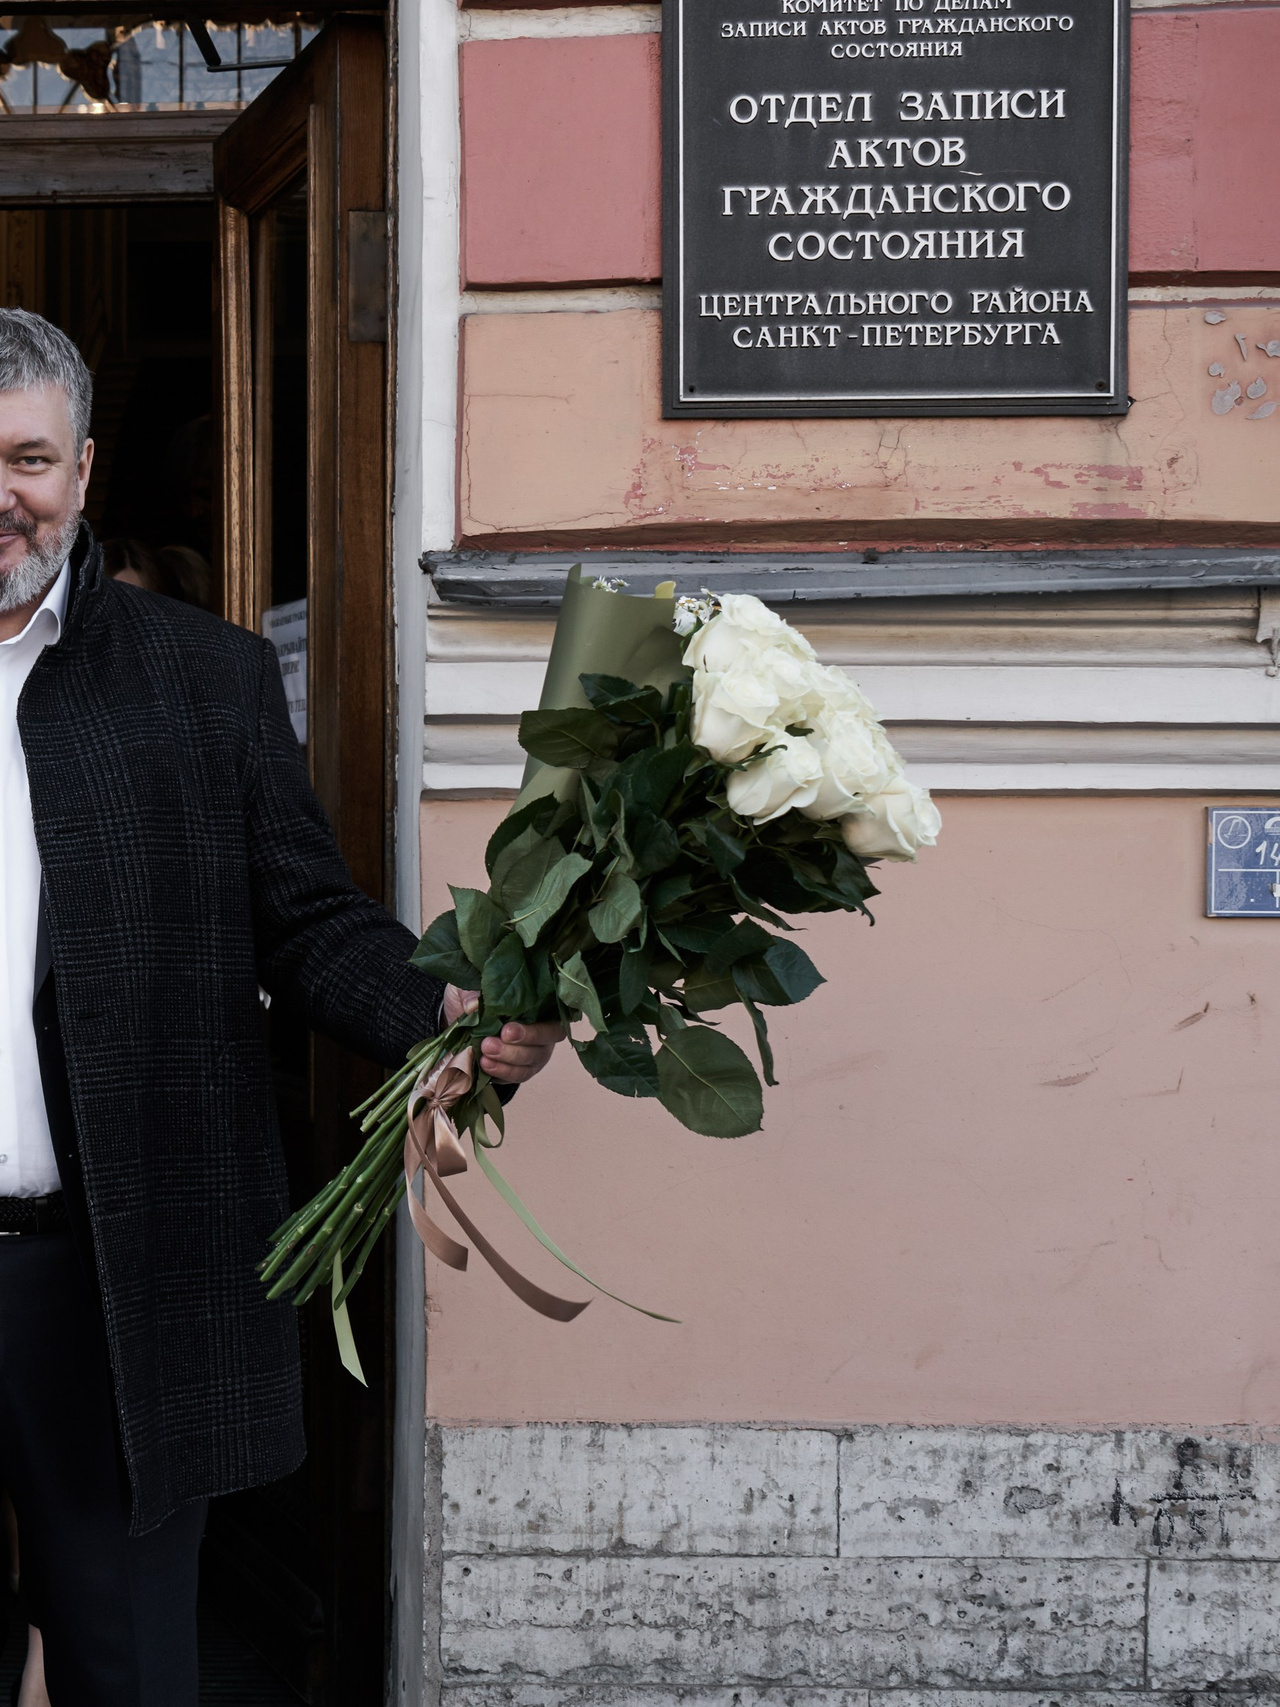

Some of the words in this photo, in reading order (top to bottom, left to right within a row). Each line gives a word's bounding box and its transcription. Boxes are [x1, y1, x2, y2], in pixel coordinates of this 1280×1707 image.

[783, 0, 882, 13] КОМИТЕТ
[896, 0, 923, 10] ПО
[722, 21, 806, 37] ЗАПИСИ
[820, 20, 886, 35] АКТОВ
[899, 16, 1073, 35] ГРАЖДАНСКОГО
[832, 42, 962, 58] СОСТОЯНИЯ
[730, 93, 872, 128] ОТДЕЛ
[900, 90, 1065, 120] ЗАПИСИ
[829, 138, 966, 167] АКТОВ
[723, 182, 1070, 219] ГРАЖДАНСКОГО
[769, 230, 1024, 260] СОСТОЯНИЯ
[700, 292, 952, 320] ЦЕНТРАЛЬНОГО
[972, 288, 1093, 313] РАЙОНА
[733, 323, 1060, 347] САНКТ-ПЕТЕРБУРГА
